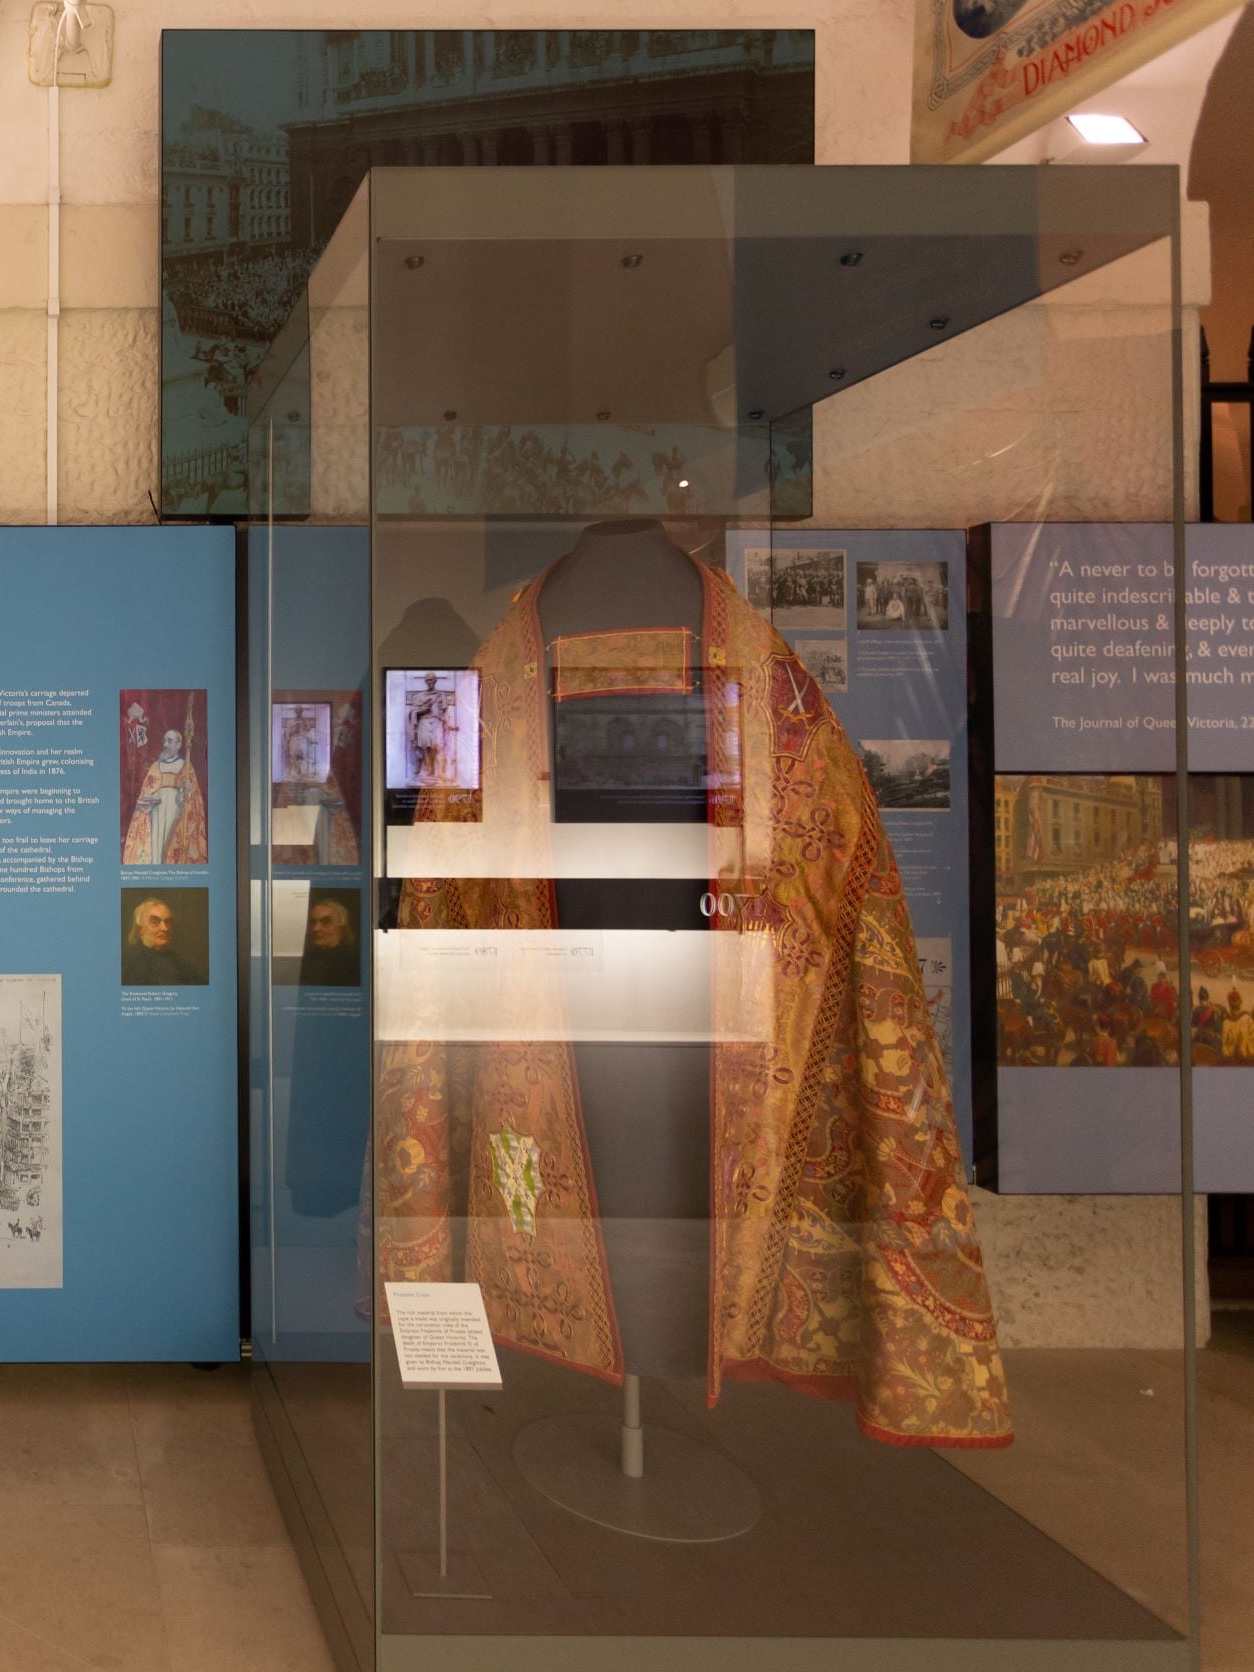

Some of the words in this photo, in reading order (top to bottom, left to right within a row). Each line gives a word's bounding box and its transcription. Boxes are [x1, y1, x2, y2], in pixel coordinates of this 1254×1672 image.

[1022, 3, 1135, 96] DIAMOND
[1081, 564, 1130, 577] never
[1138, 562, 1157, 577] to
[1164, 561, 1174, 577] b
[1050, 588, 1095, 608] quite
[1103, 588, 1220, 604] indescriable
[1227, 587, 1241, 604] &
[1050, 614, 1149, 630] marvellous
[1155, 614, 1169, 630] &
[1185, 614, 1234, 635] eeply
[1051, 641, 1096, 662] quite
[1198, 641, 1211, 657] &
[1052, 667, 1084, 684] real
[1091, 668, 1121, 688] joy.
[1132, 667, 1136, 684] I
[1144, 671, 1176, 684] was
[1186, 667, 1233, 684] much
[30, 690, 56, 699] carriage
[59, 690, 89, 699] departed
[3, 699, 25, 708] troops
[9, 709, 28, 718] prime
[26, 719, 55, 728] proposal
[1052, 716, 1076, 729] The
[1079, 716, 1122, 731] Journal
[1127, 716, 1139, 729] of
[1143, 716, 1176, 731] Quee
[1187, 716, 1238, 730] Victoria,
[16, 758, 40, 767] Empire
[61, 758, 94, 767] colonising
